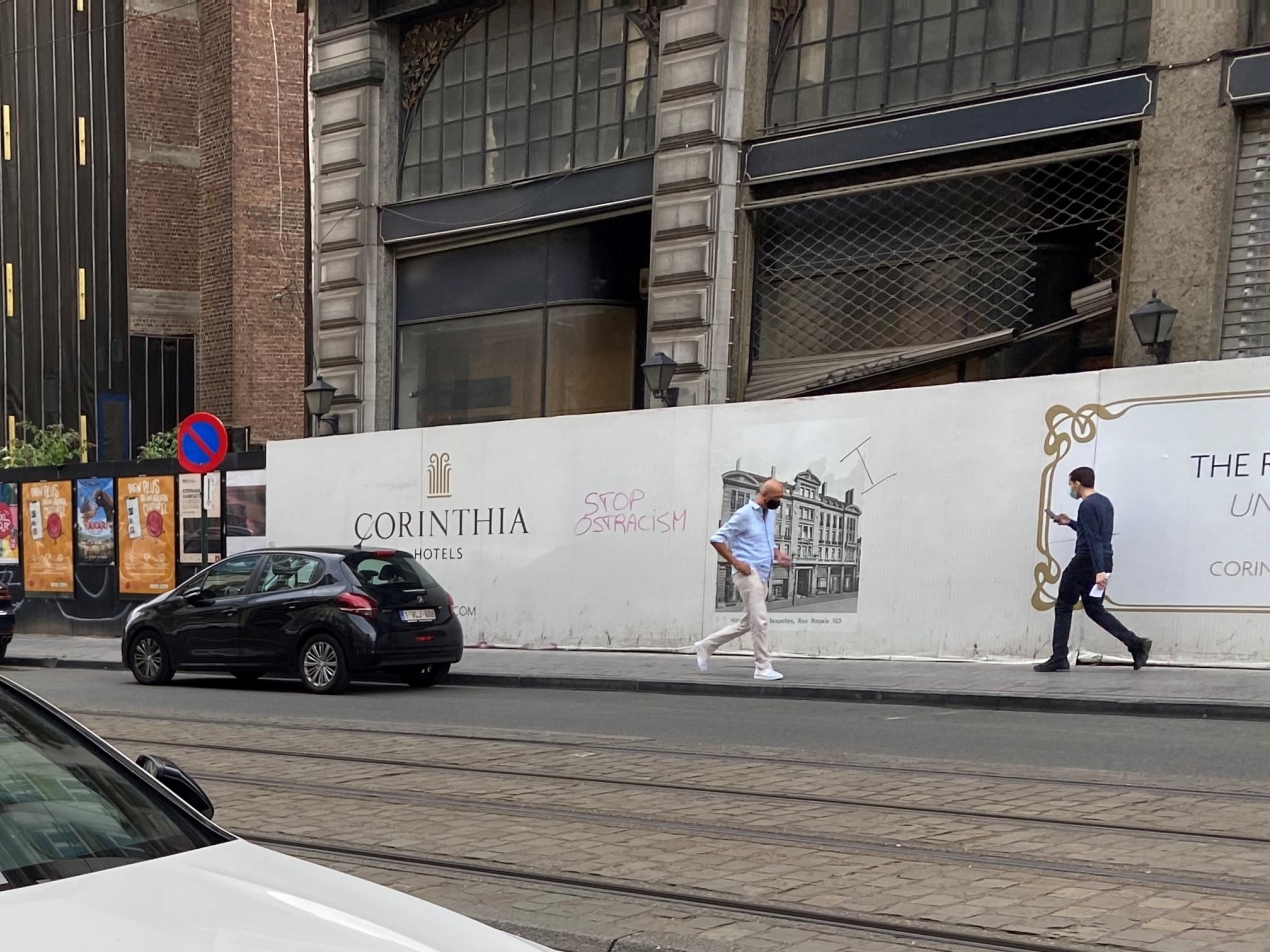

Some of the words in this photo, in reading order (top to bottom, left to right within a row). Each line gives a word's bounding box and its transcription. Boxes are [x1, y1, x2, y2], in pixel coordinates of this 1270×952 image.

[1190, 453, 1250, 478] THE
[585, 489, 645, 516] STOP
[354, 507, 529, 541] CORINTHIA
[414, 548, 463, 560] HOTELS
